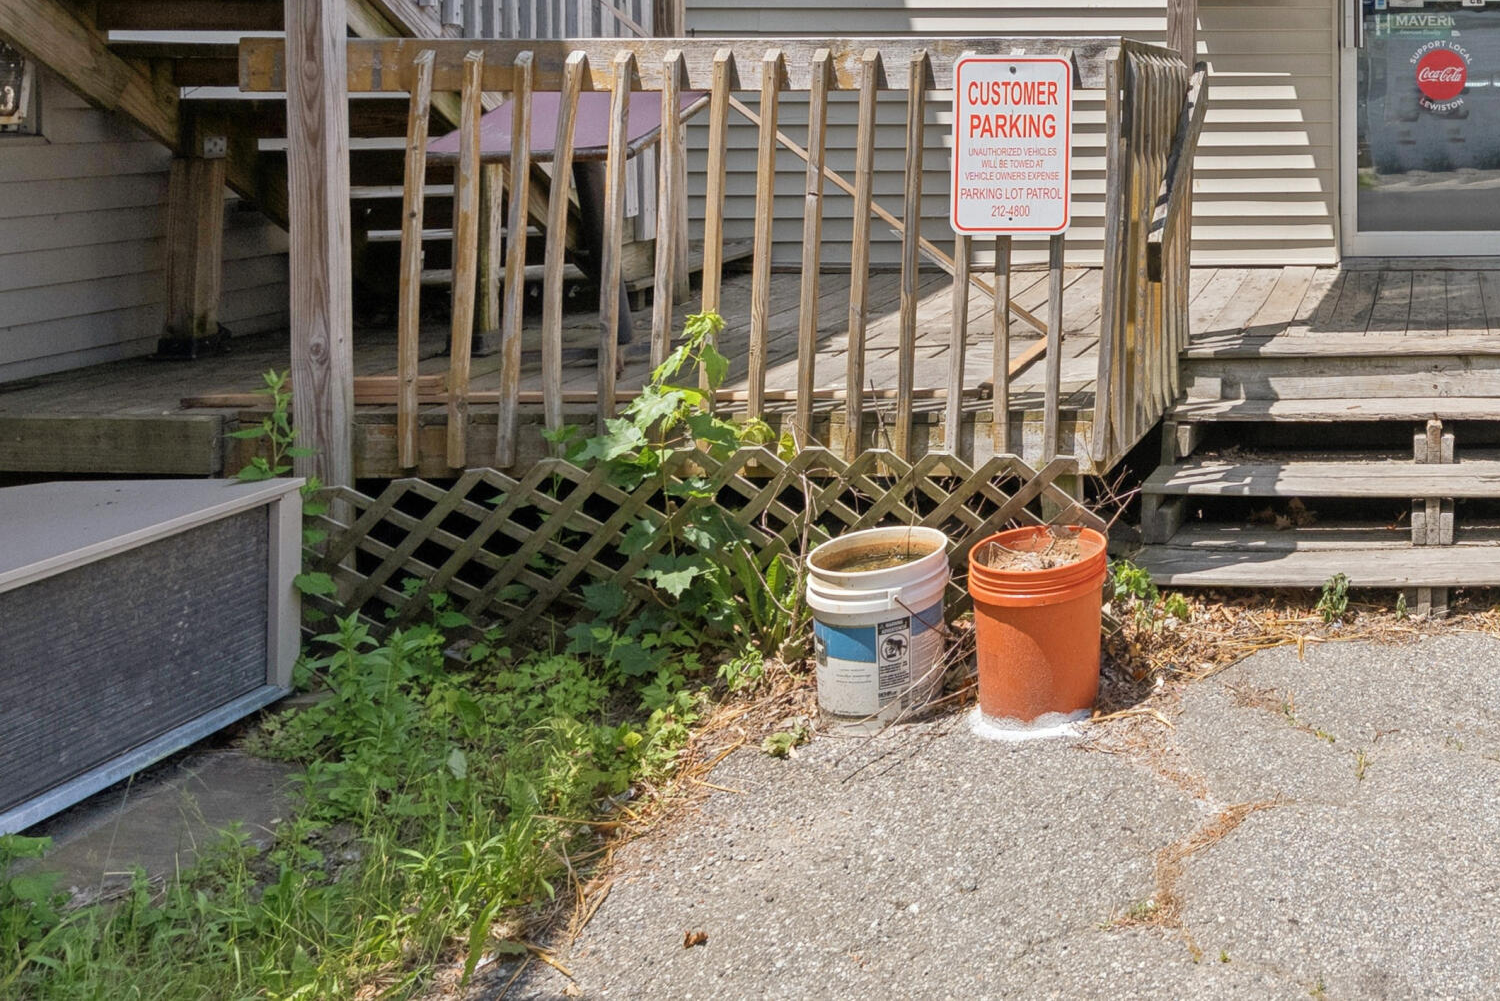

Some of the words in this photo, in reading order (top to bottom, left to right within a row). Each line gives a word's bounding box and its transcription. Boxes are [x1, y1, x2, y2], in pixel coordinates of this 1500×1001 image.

[1410, 40, 1446, 64] SUPPORT
[1449, 42, 1473, 65] LOCAL
[1419, 67, 1464, 82] Coca-Cola
[968, 81, 1058, 105] CUSTOMER
[1420, 98, 1464, 111] LEWISTON
[969, 114, 1056, 139] PARKING
[968, 148, 1022, 157] UNAUTHORIZED
[1023, 148, 1057, 157] VEHICLES
[981, 159, 997, 168] WILL
[999, 159, 1008, 168] BE
[1010, 159, 1034, 168] TOWED
[1035, 159, 1044, 168] AT
[965, 172, 994, 180] VEHICLE
[995, 172, 1026, 180] OWNERS
[1027, 172, 1060, 180] EXPENSE
[961, 188, 1003, 199] PARKING
[1005, 188, 1024, 199] LOT
[1026, 188, 1062, 199] PATROL
[991, 205, 1030, 217] 212-4800
